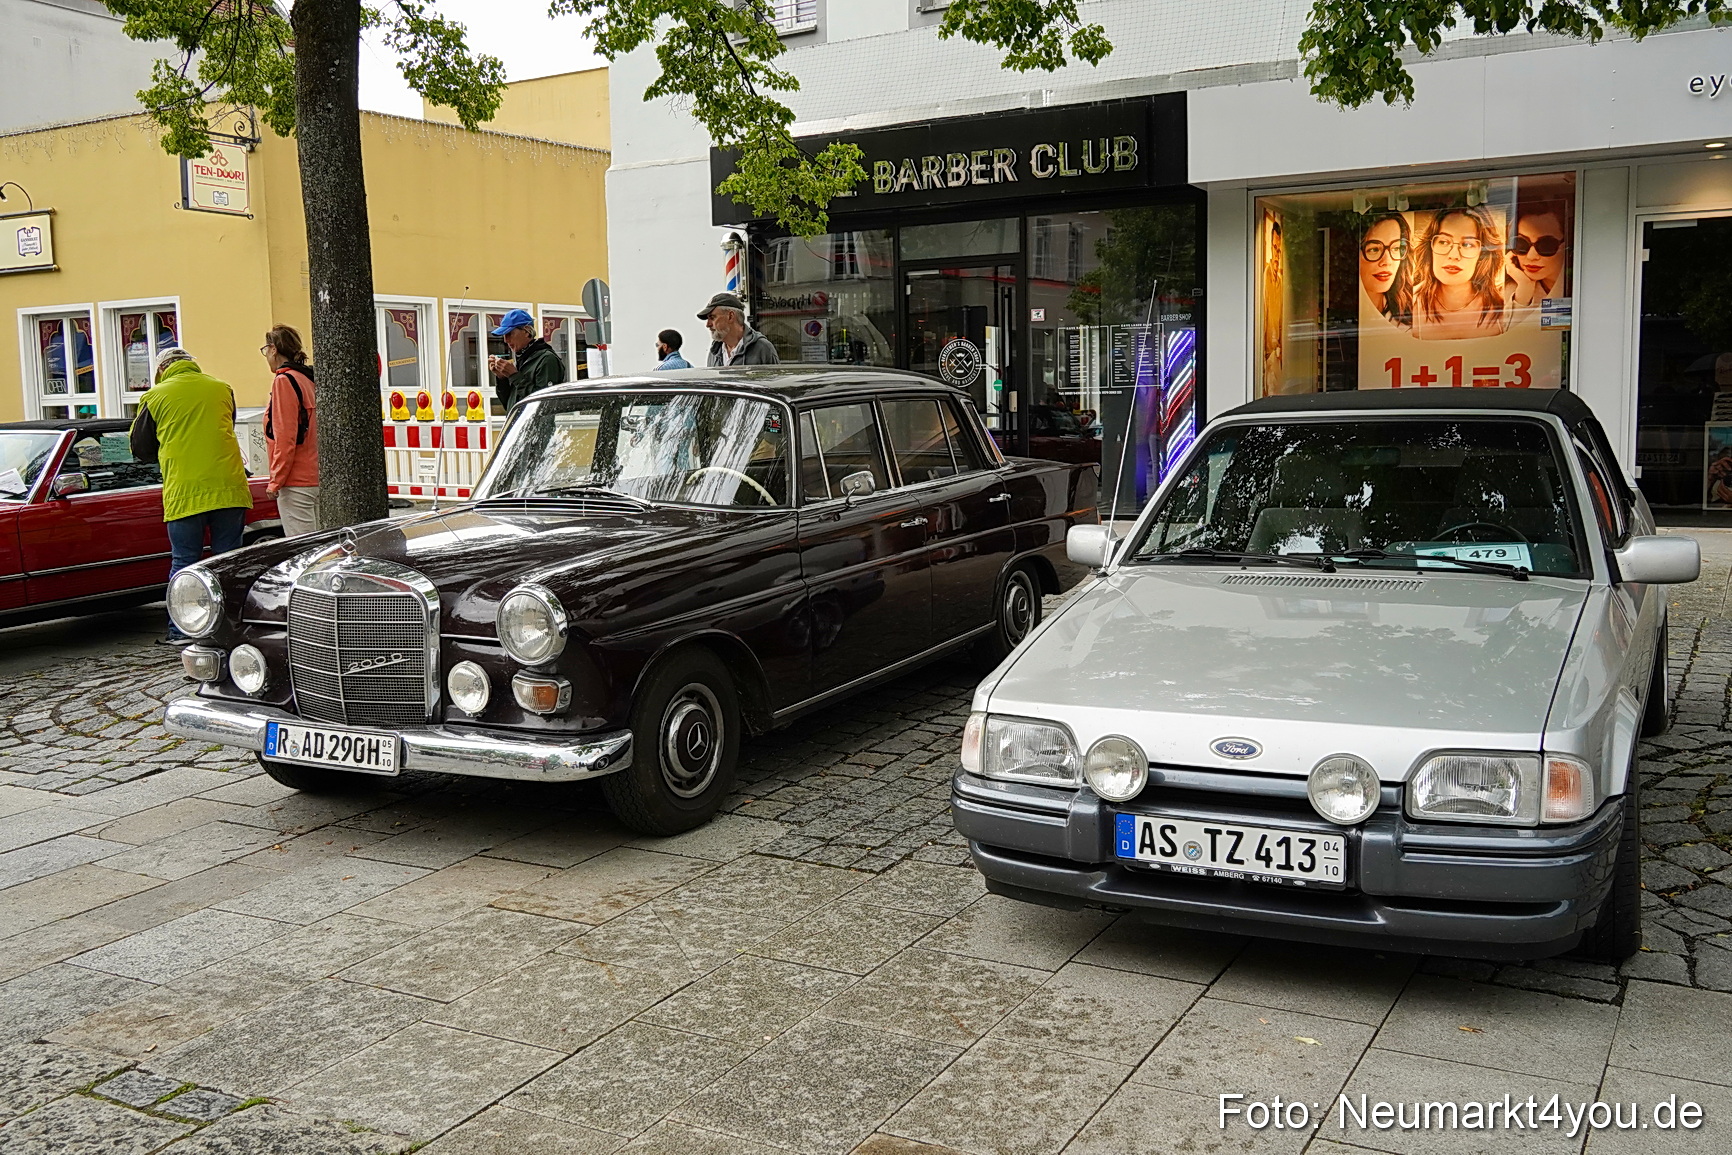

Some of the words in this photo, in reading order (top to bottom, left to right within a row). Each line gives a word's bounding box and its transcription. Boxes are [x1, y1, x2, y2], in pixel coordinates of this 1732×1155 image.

[1689, 74, 1732, 98] ey
[873, 147, 1018, 195] BARBER
[1029, 135, 1139, 179] CLUB
[1160, 313, 1179, 322] BARBER
[1179, 312, 1192, 321] SHOP
[47, 380, 67, 393] OPEN
[1469, 549, 1507, 558] 479
[268, 742, 275, 750] D
[277, 728, 289, 754] R
[302, 731, 325, 759] AD
[328, 734, 380, 765] 290H
[382, 740, 392, 748] 05
[1222, 742, 1249, 754] Ford
[382, 758, 392, 767] 10
[1121, 840, 1130, 850] D
[1138, 821, 1177, 858] AS
[1204, 828, 1245, 865] TZ
[1255, 834, 1316, 873] 413
[1323, 840, 1339, 852] 04
[1172, 865, 1206, 875] WEISS
[1213, 870, 1245, 880] AMBERG
[1262, 875, 1283, 884] 67140
[1324, 865, 1339, 876] 10
